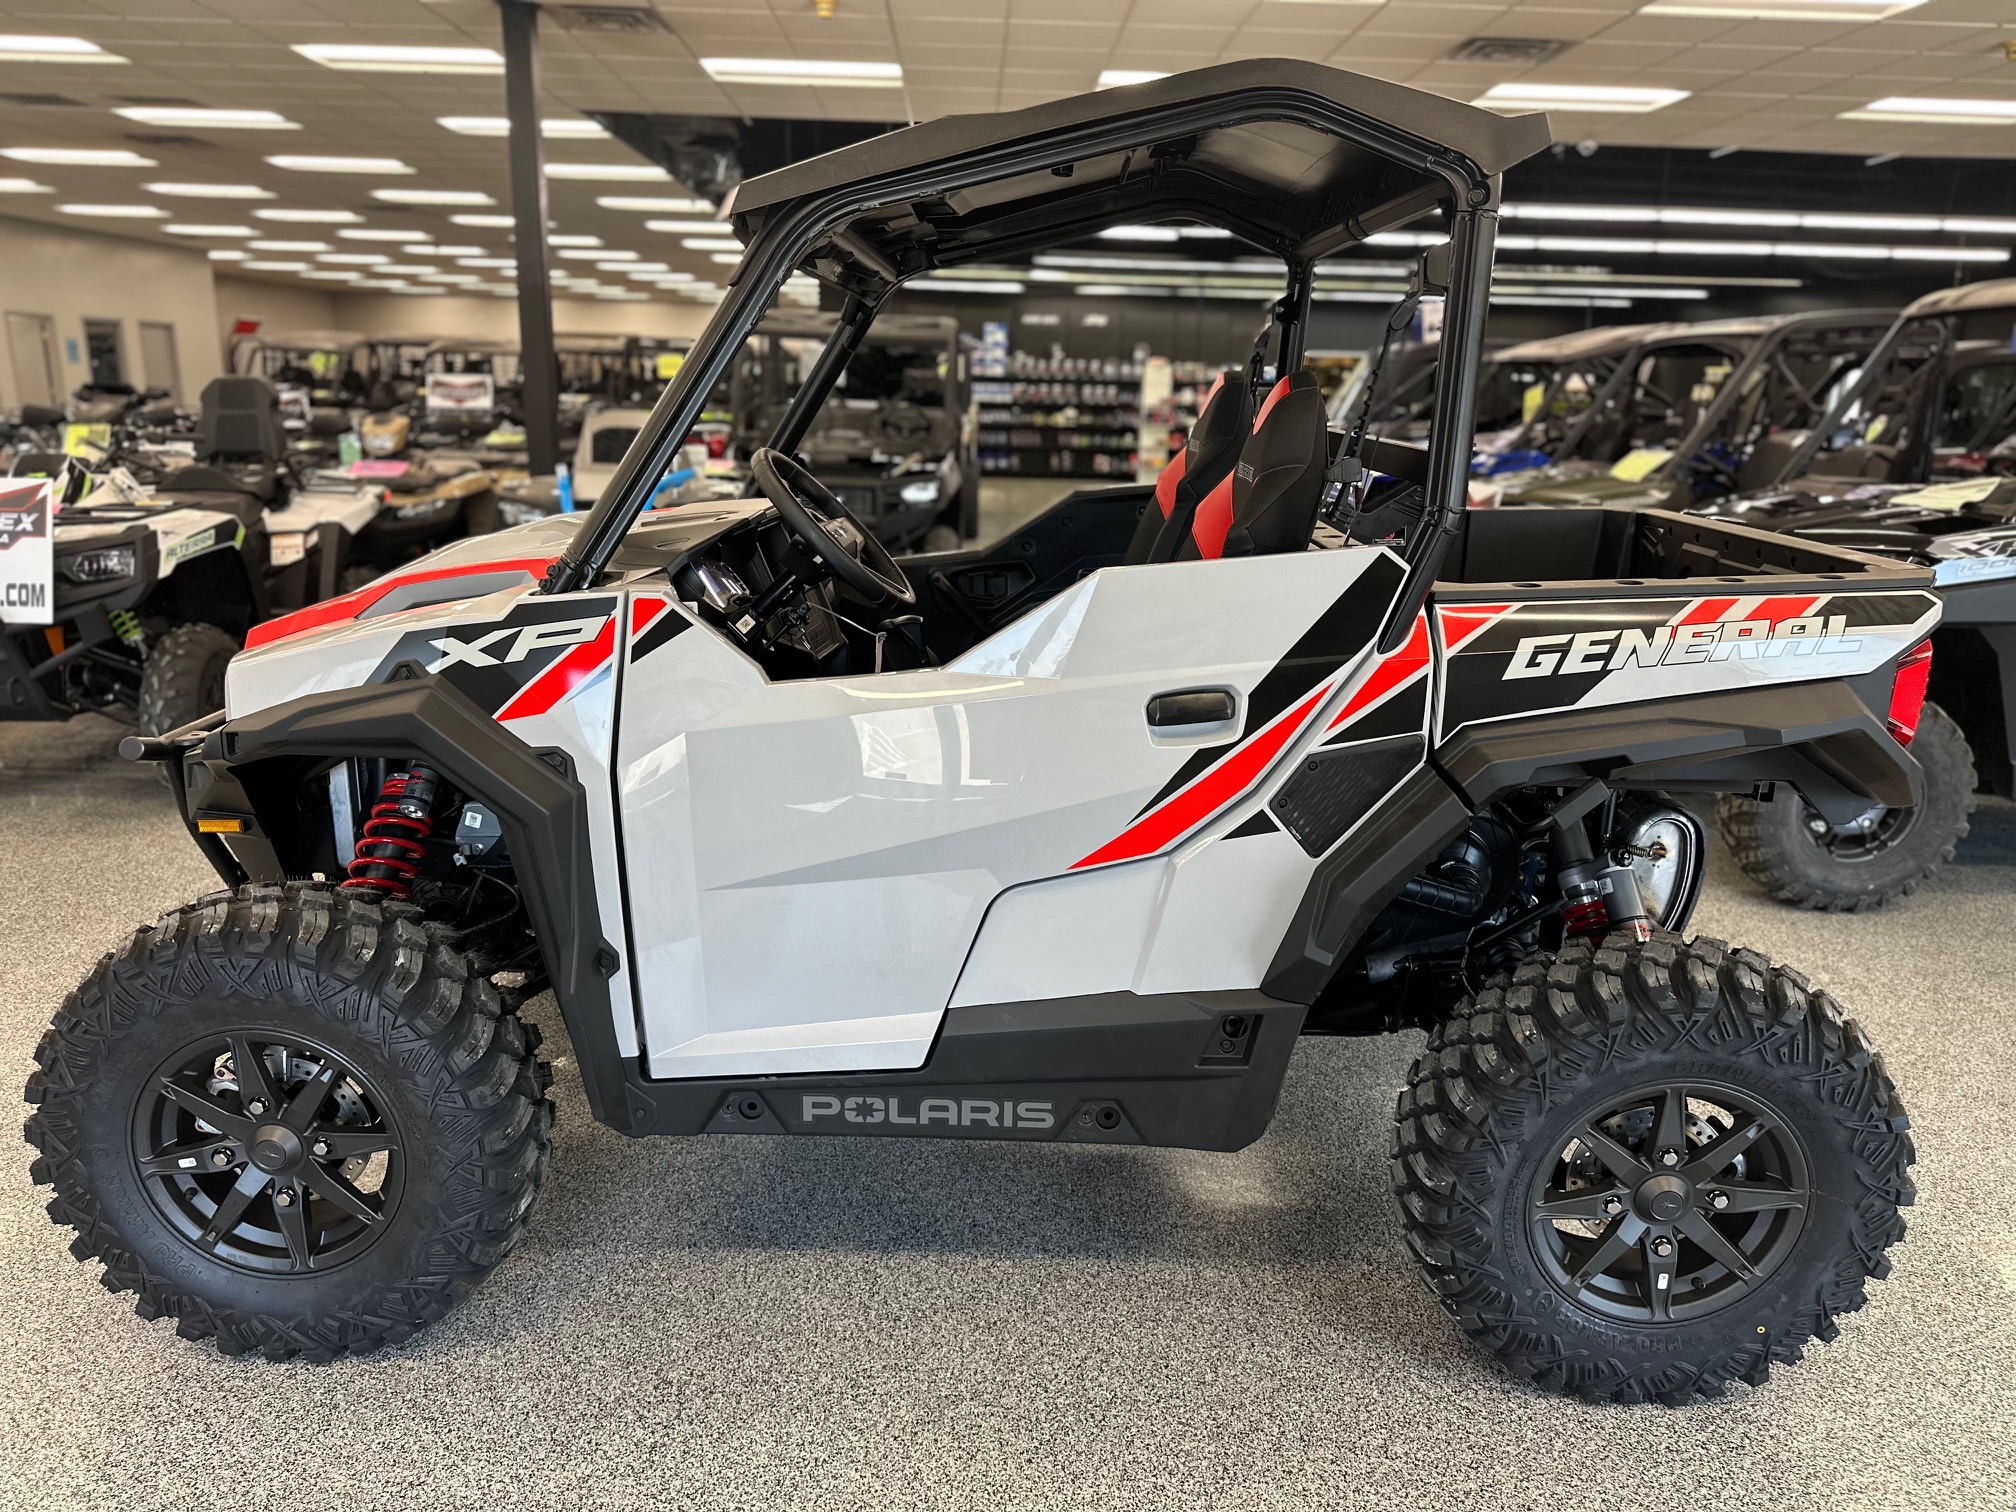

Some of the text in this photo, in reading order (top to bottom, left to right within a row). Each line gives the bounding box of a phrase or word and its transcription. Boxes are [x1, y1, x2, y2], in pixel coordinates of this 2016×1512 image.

[425, 614, 612, 674] XP
[1500, 614, 1864, 681] GENERAL
[802, 1095, 1056, 1129] POLARIS
